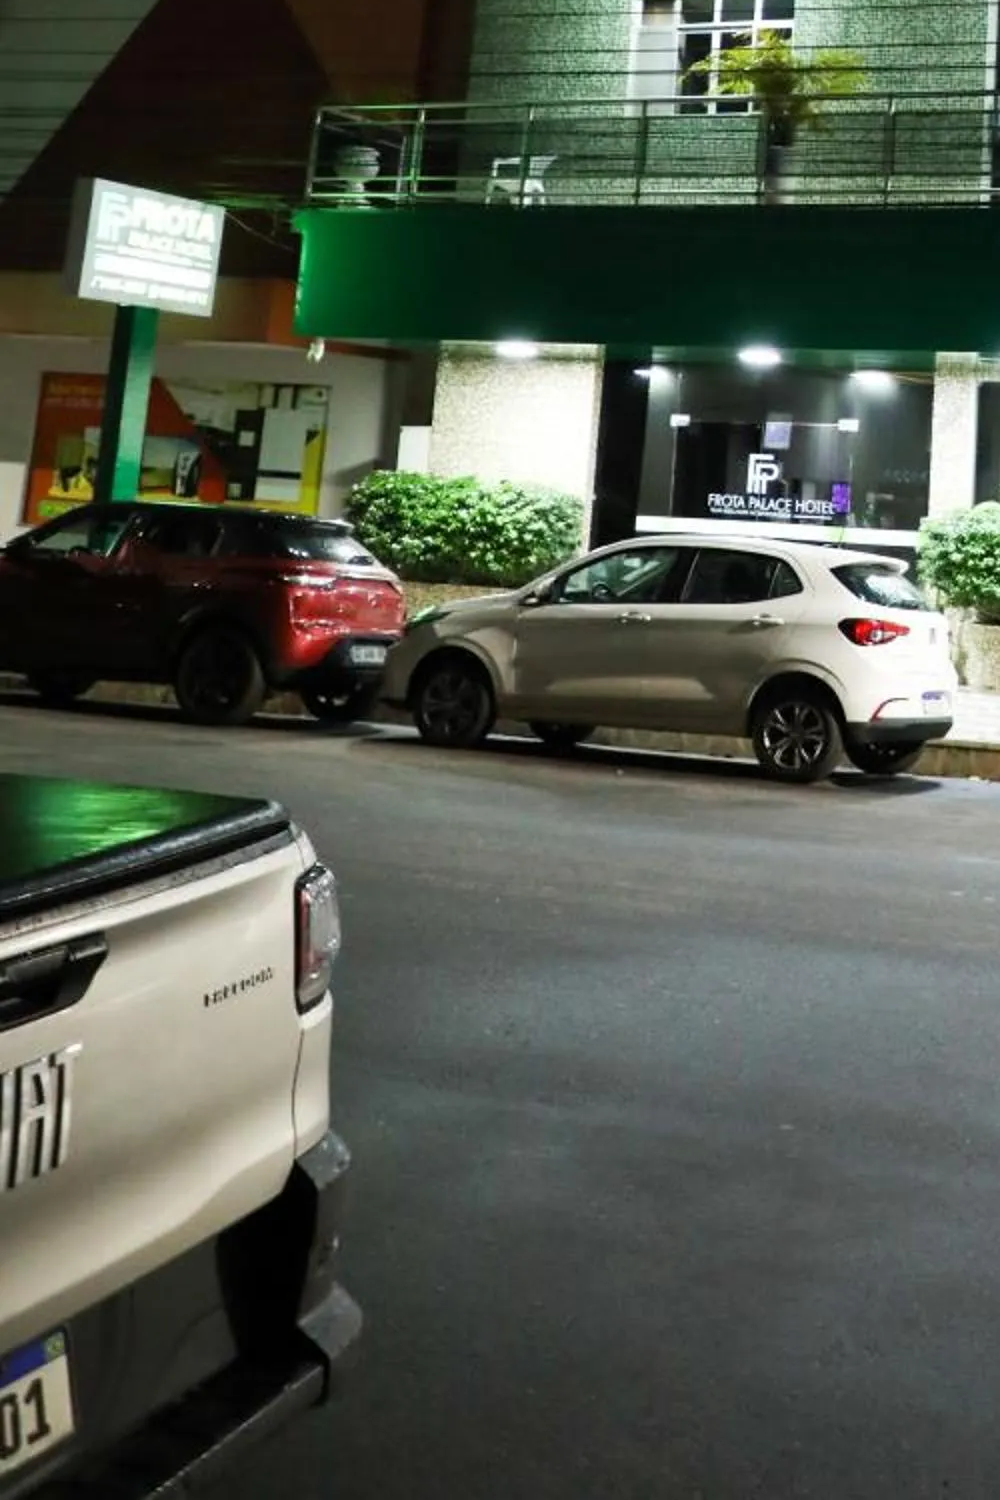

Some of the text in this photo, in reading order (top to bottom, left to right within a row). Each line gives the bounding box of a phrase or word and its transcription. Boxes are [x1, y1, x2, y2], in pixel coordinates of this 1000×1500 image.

[131, 197, 216, 243] FROTA
[707, 493, 746, 508] FROTA
[748, 496, 793, 512] PALACE
[795, 499, 836, 515] HOTEL
